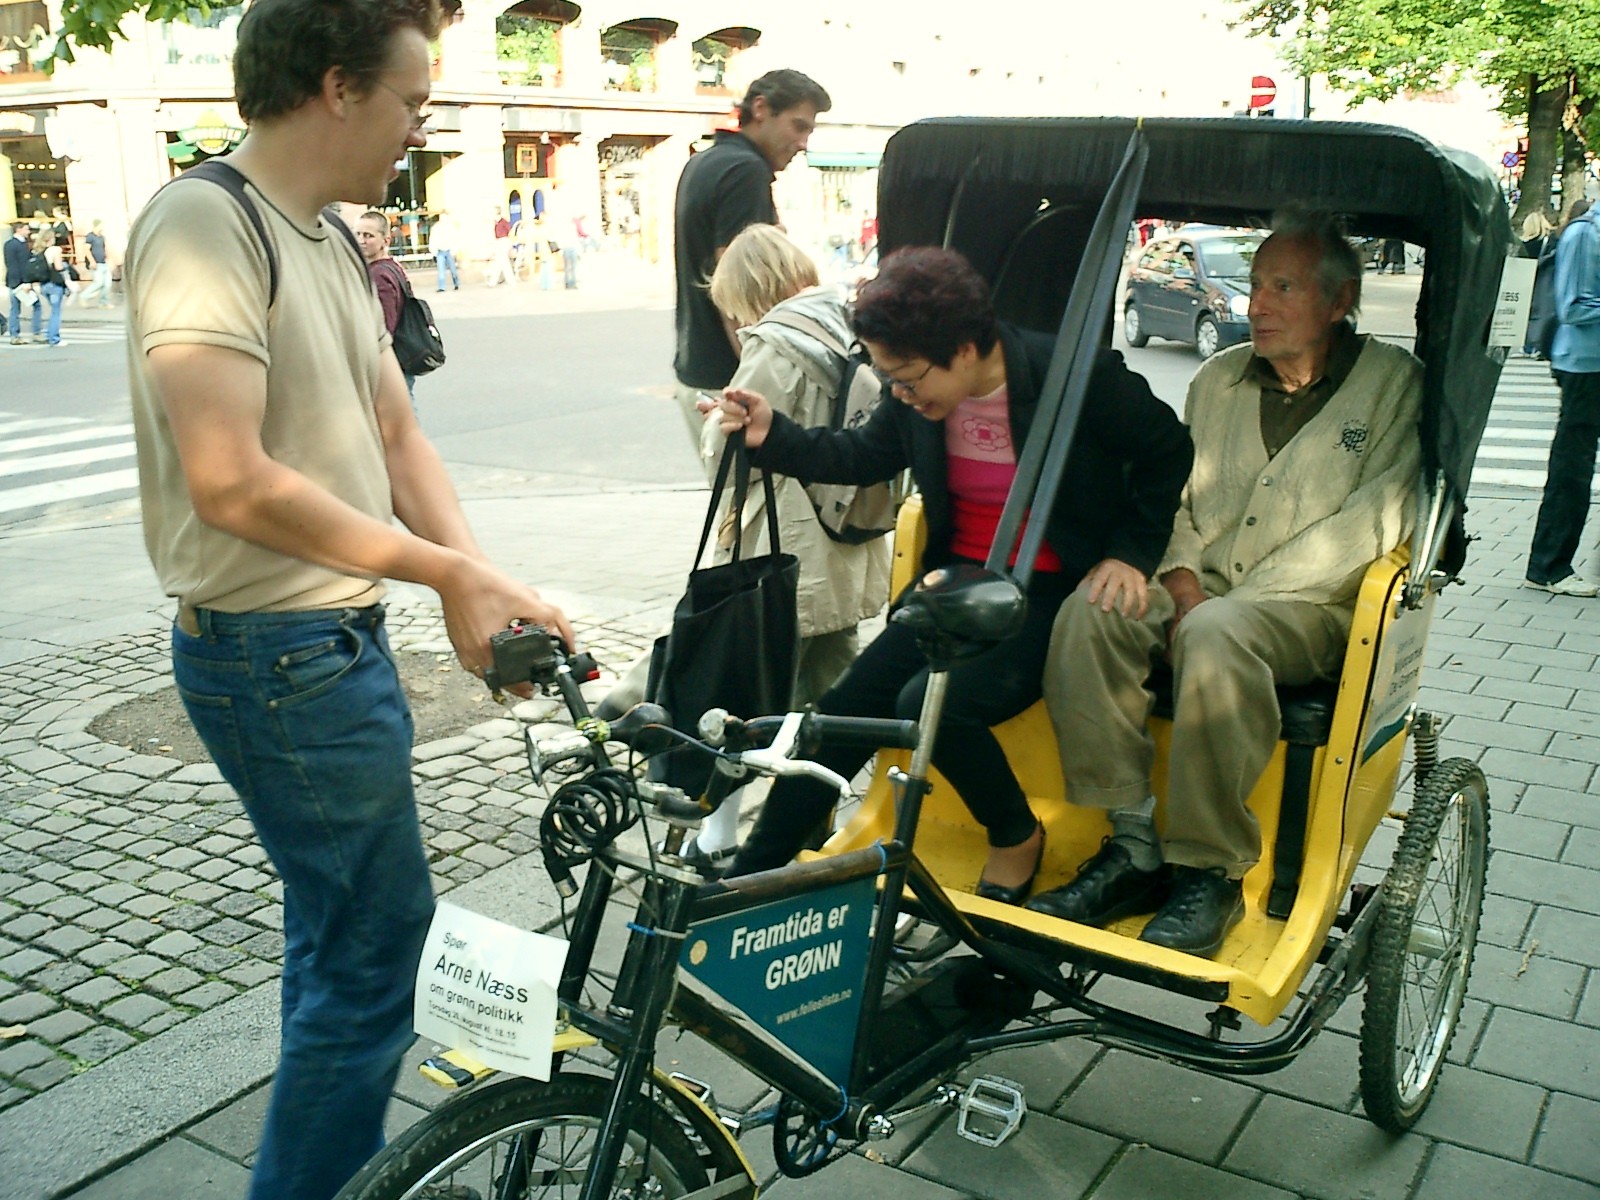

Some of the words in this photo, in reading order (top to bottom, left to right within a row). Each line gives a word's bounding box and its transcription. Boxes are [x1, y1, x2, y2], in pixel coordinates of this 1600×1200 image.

[443, 932, 468, 951] Spør
[730, 908, 824, 960] Framtida
[827, 904, 850, 930] er
[434, 954, 472, 984] Arne
[476, 969, 529, 1003] Næss
[765, 939, 843, 990] GRØNN
[430, 983, 445, 997] om
[447, 990, 476, 1010] grønn
[477, 1003, 524, 1025] politikk
